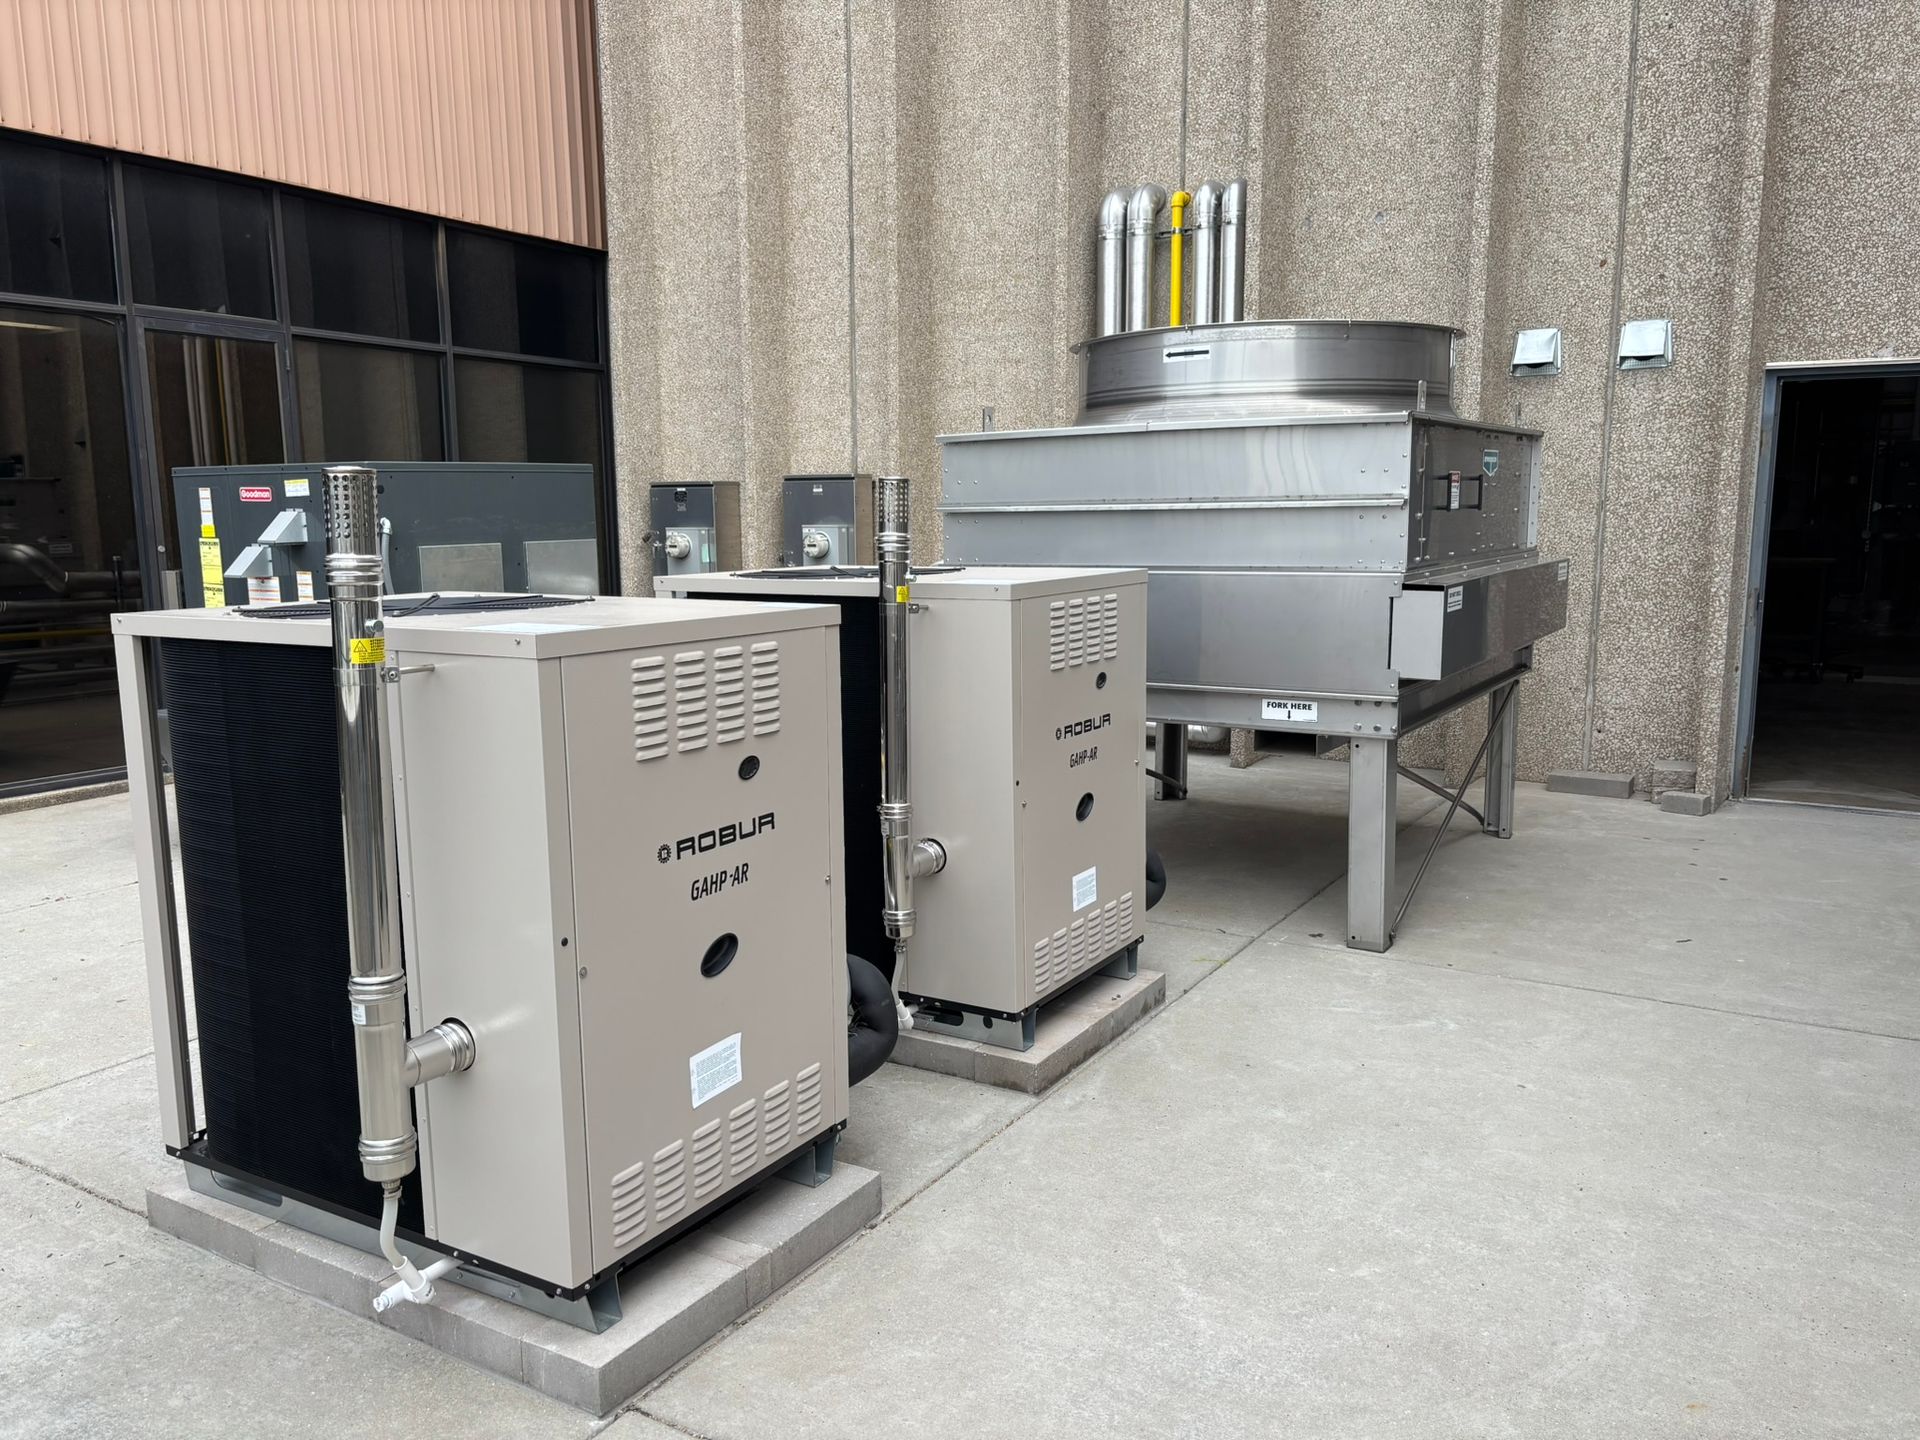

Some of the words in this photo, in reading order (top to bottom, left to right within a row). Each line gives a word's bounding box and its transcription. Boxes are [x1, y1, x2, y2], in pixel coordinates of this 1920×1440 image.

[241, 489, 270, 498] Goodman
[1266, 701, 1289, 709] FORK
[1290, 702, 1313, 711] HERE
[1064, 713, 1111, 739] ROBUR
[1070, 746, 1098, 768] GAHP-AR
[676, 811, 775, 861] ROBUR
[691, 862, 749, 901] GAHP-AR
